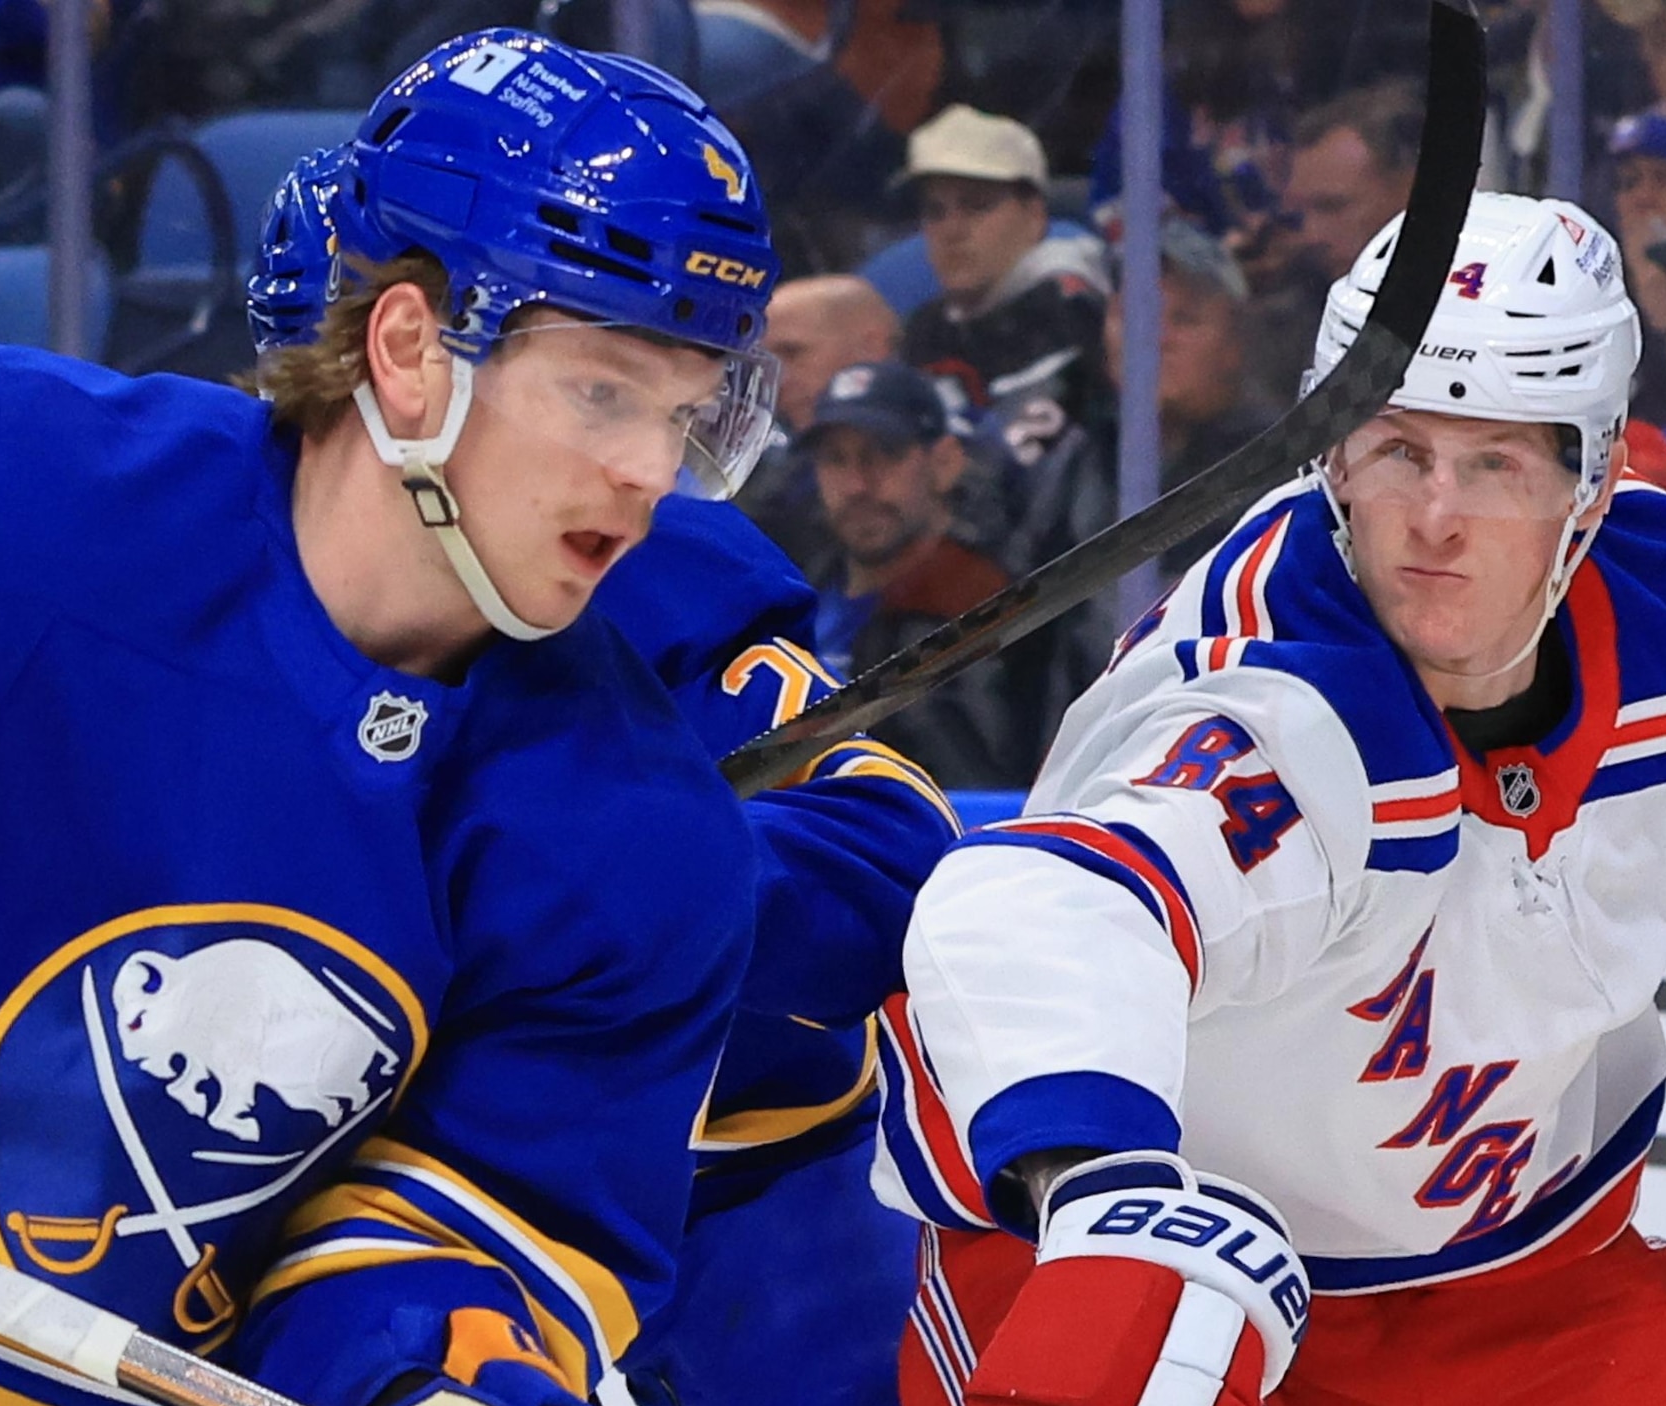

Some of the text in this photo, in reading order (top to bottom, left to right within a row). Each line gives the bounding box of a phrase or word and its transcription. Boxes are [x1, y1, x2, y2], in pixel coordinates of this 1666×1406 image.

[511, 72, 556, 104] Nurse
[527, 61, 588, 102] Trusted
[497, 86, 555, 129] Staffing
[684, 250, 767, 289] CCM
[370, 716, 413, 742] NHL
[1130, 714, 1303, 874] 84
